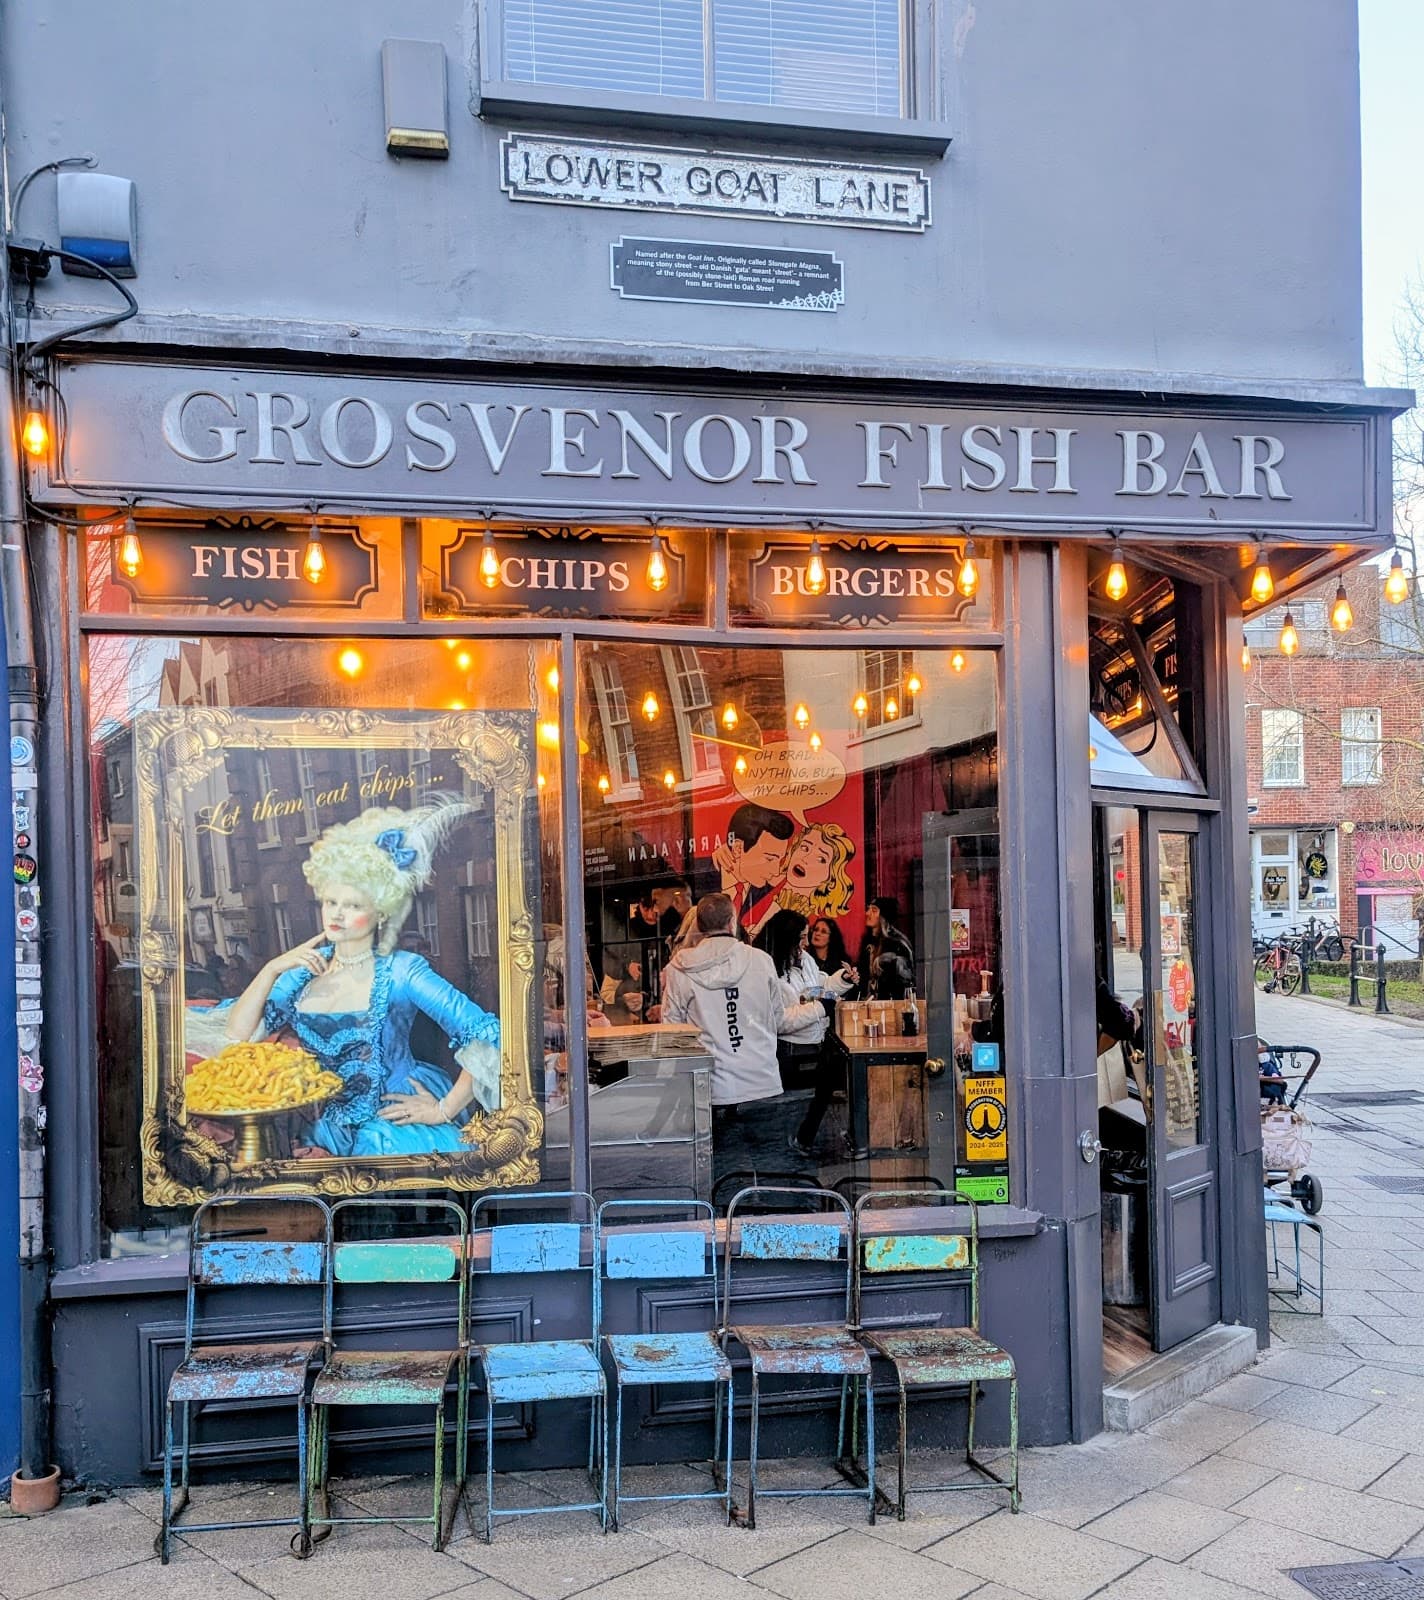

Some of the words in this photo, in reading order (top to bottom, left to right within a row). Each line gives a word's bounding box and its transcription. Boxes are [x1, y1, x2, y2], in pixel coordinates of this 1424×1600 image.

[523, 152, 665, 194] LOWER
[686, 166, 787, 204] GOAT
[814, 177, 910, 216] LANE
[627, 259, 654, 268] meaning
[655, 261, 672, 269] stony
[751, 267, 772, 275] meant
[804, 272, 830, 280] remnant
[635, 250, 658, 258] Named
[659, 251, 674, 260] after
[676, 251, 687, 260] the
[687, 253, 702, 261] Goat
[703, 254, 716, 263] Inn.
[717, 255, 747, 265] Originally
[748, 258, 767, 266] called
[768, 259, 798, 269] Stonegate
[799, 261, 822, 271] Magna,
[675, 270, 703, 280] (possibly
[704, 273, 737, 281] stone-laid)
[738, 274, 760, 283] Roman
[776, 278, 800, 287] running
[714, 281, 733, 289] Street
[162, 390, 818, 486] GROSVENOR
[856, 420, 1079, 495] FISH
[1115, 430, 1294, 500] BAR
[191, 544, 300, 581] FISH
[500, 557, 630, 592] CHIPS
[754, 750, 773, 761] OH
[745, 767, 809, 779] NYTHING,
[812, 767, 838, 778] BUT
[196, 799, 241, 835] Let
[252, 789, 304, 823] them
[316, 782, 348, 808] eat
[359, 764, 416, 801] chips
[753, 784, 775, 797] MY
[779, 784, 829, 796] CHIPS...
[724, 986, 744, 1053] Bench.
[1166, 1017, 1196, 1049] EXIT
[968, 1087, 1003, 1095] MEMBER
[975, 1080, 996, 1088] NFFF
